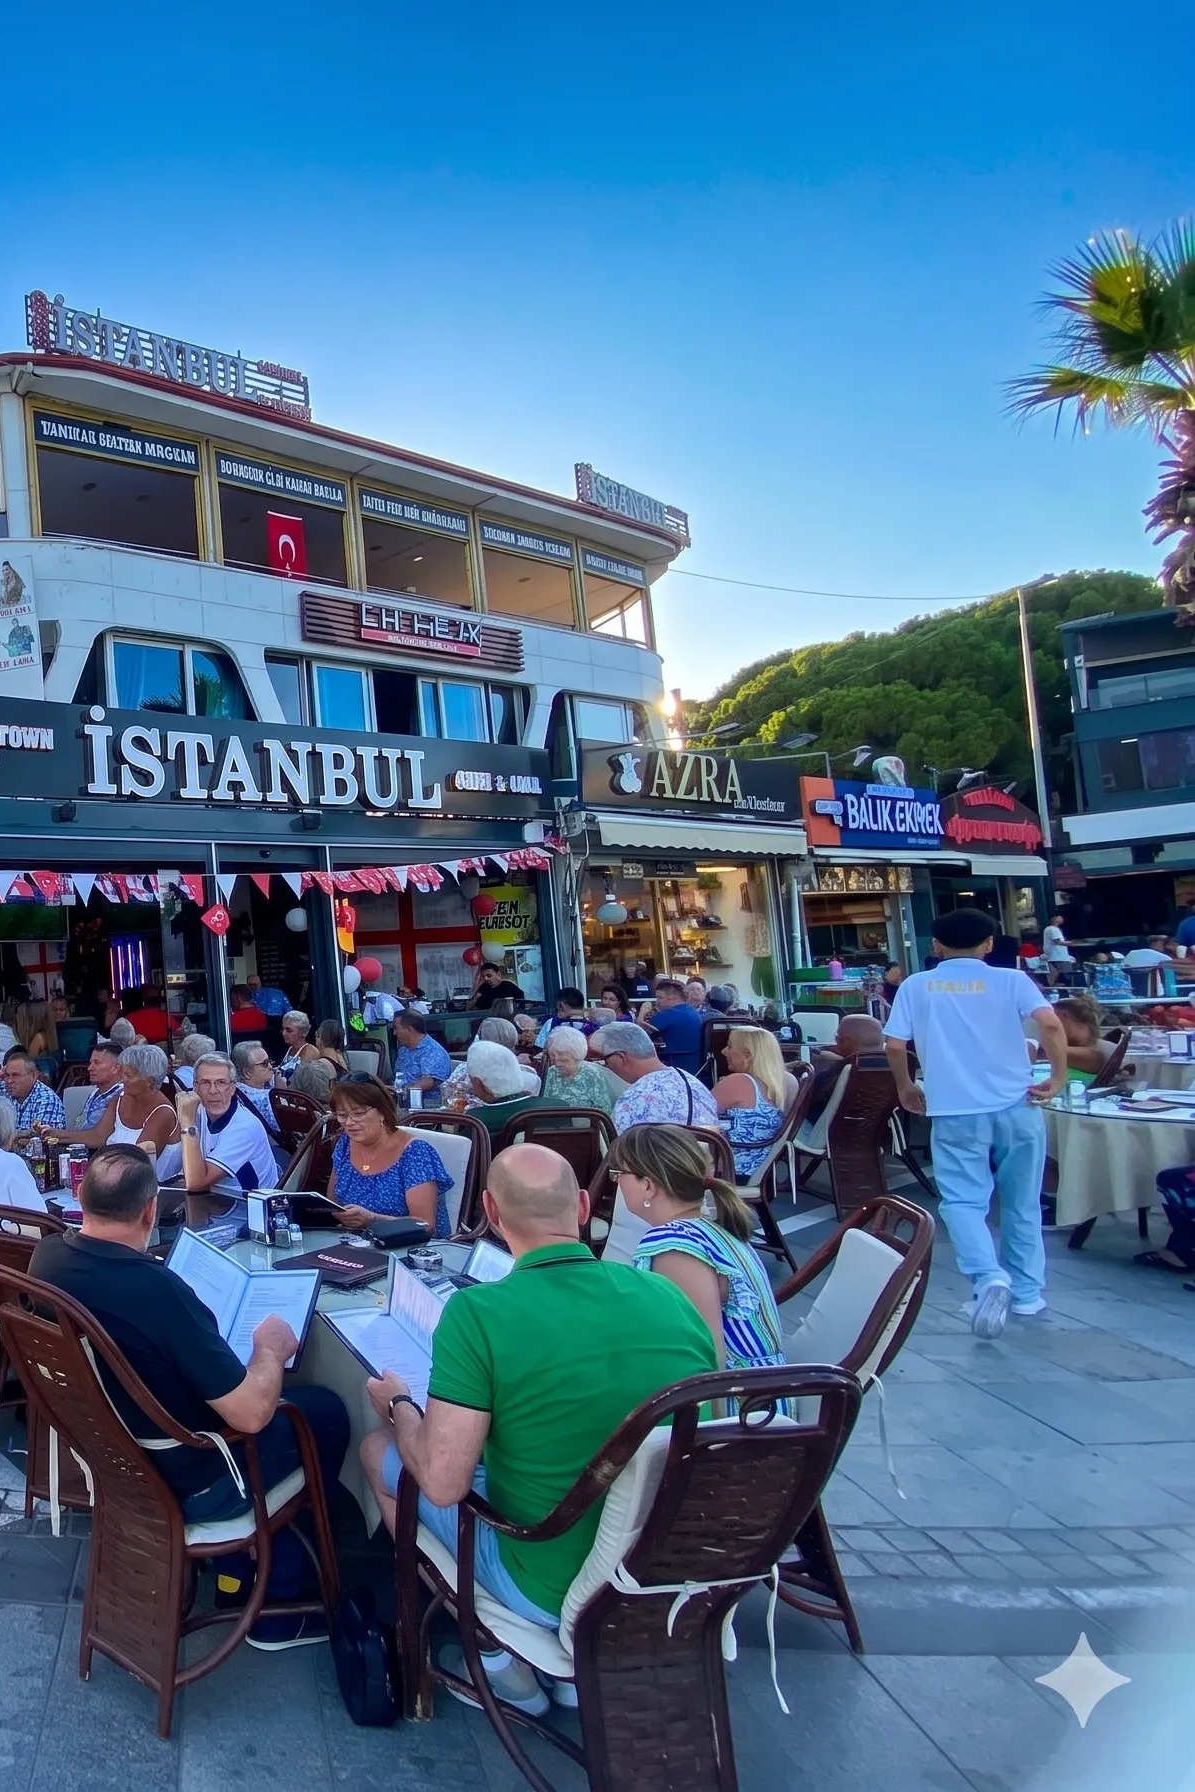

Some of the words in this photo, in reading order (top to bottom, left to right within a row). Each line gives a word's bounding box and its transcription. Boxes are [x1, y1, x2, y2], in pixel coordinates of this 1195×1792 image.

[83, 705, 442, 809] İSTANBUL
[650, 751, 744, 803] AZRA
[927, 980, 986, 992] ITALIA
